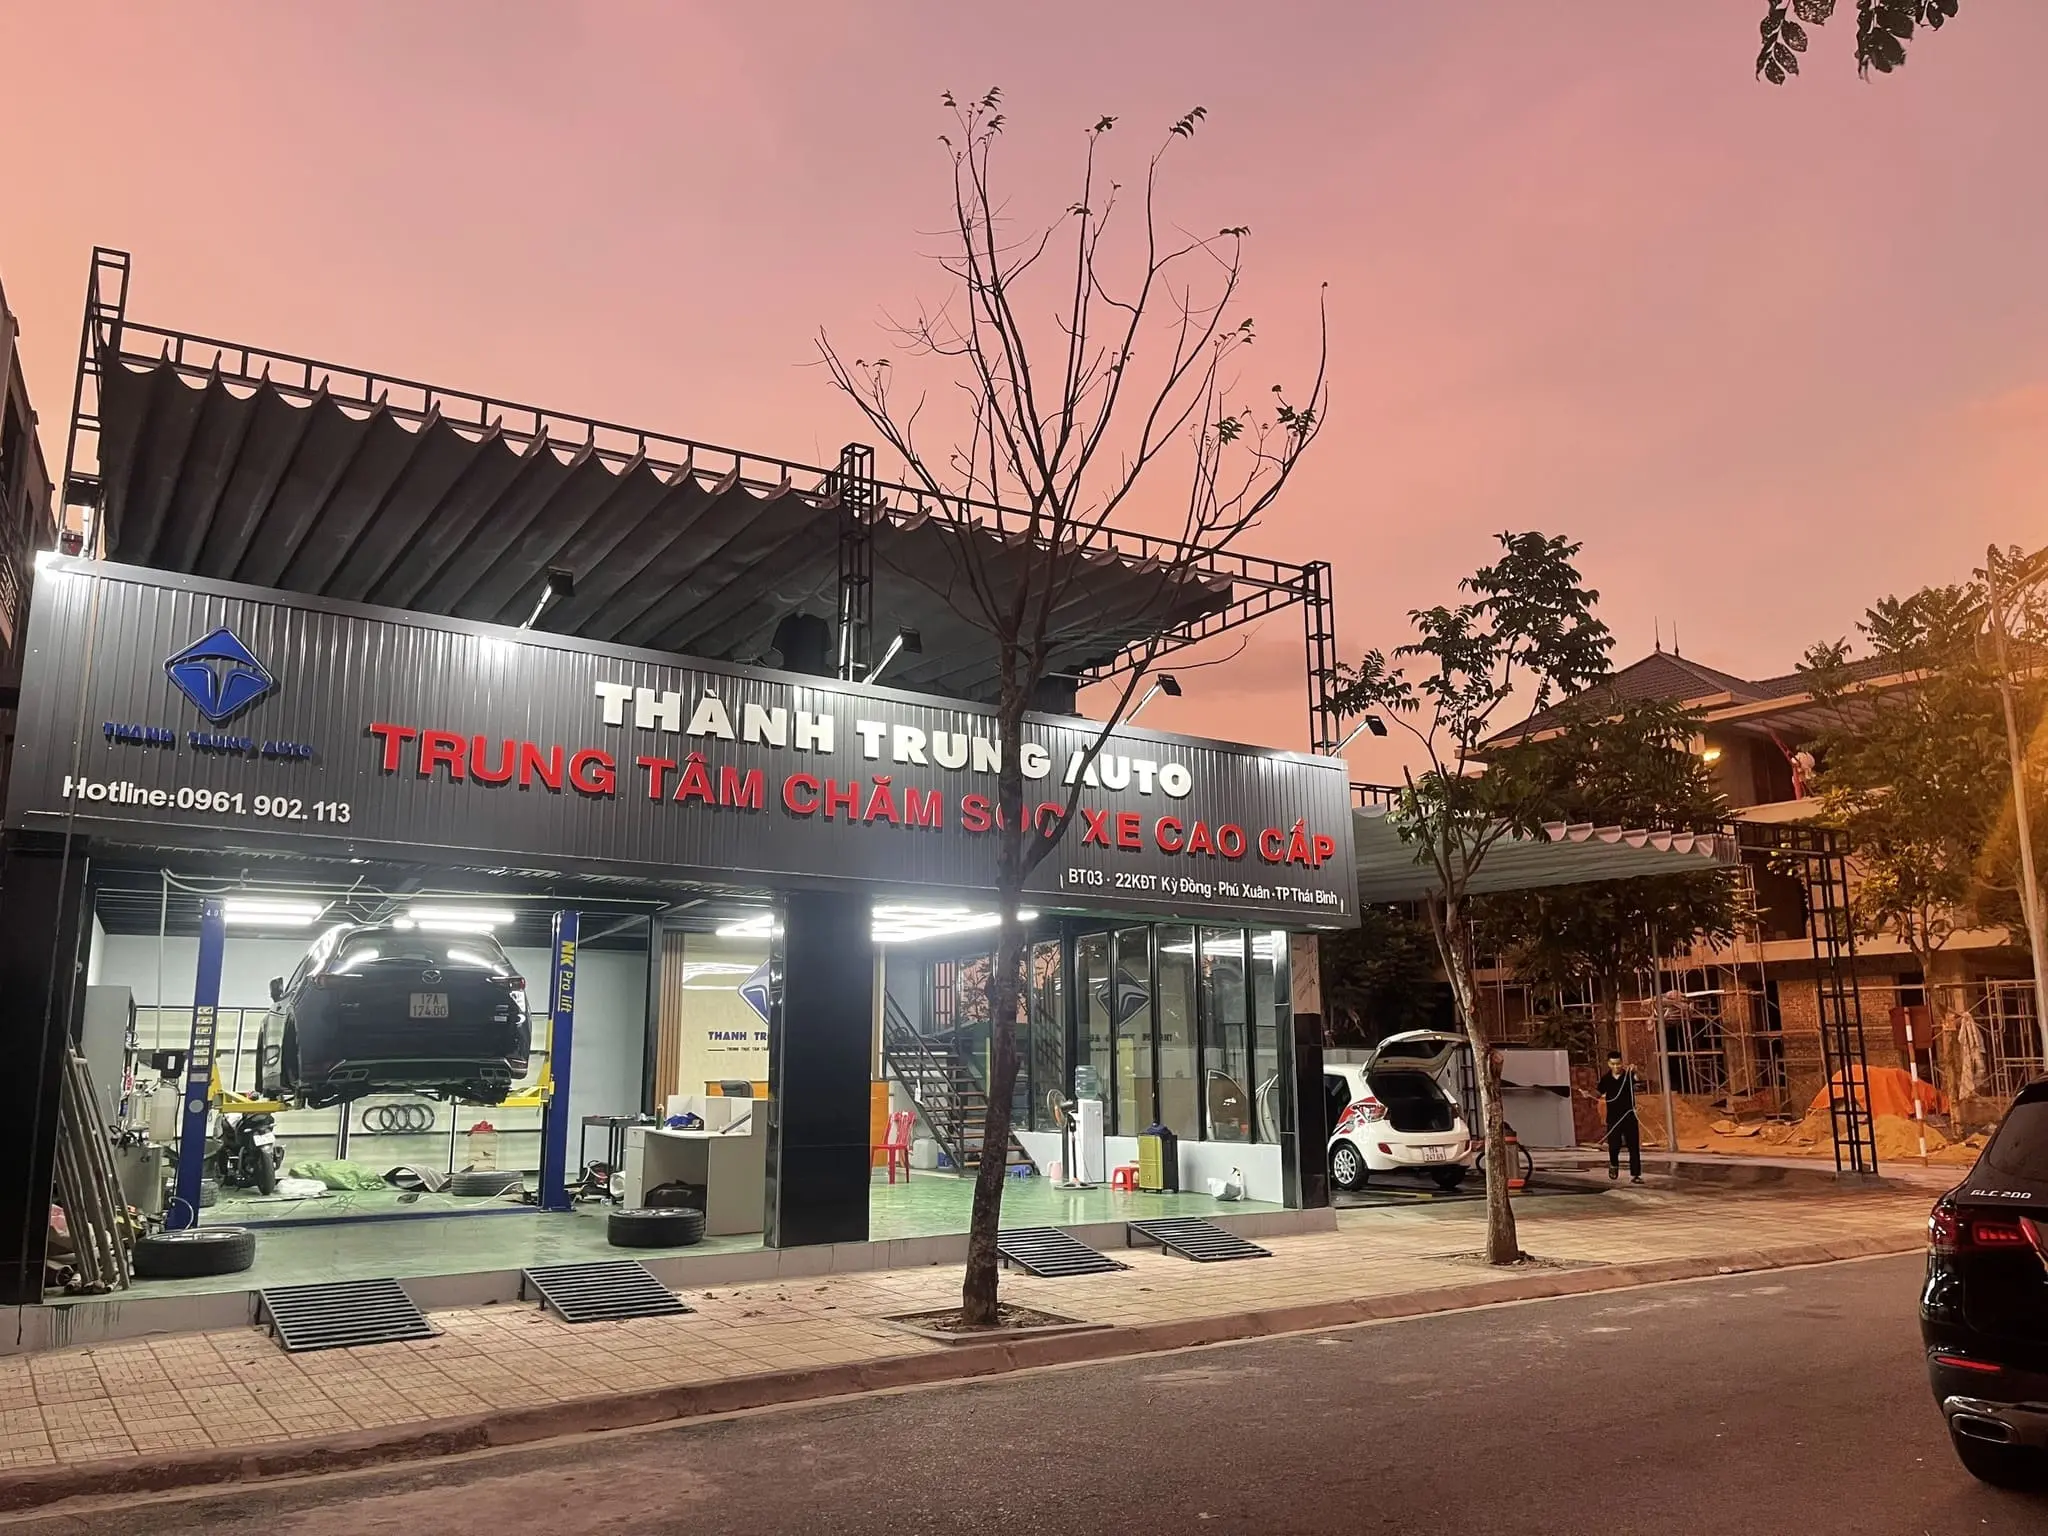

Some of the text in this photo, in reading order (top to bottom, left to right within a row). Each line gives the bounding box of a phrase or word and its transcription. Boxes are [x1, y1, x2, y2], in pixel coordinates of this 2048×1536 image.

[187, 731, 253, 750] TRUNG
[261, 740, 313, 758] AUTO
[595, 681, 834, 753] THÀNH
[1065, 751, 1192, 798] AUTO
[370, 723, 615, 795] TRUNG
[636, 752, 763, 809] TÂM
[783, 772, 943, 828] CHĂM
[1081, 808, 1143, 848] XE
[1155, 816, 1247, 858] CAO
[1259, 817, 1336, 866] CẤP
[253, 795, 307, 820] 902.
[312, 801, 351, 823] 113
[1068, 868, 1103, 887] BT03
[1115, 872, 1157, 890] 22KĐT
[1180, 876, 1212, 899] Đồng
[1219, 881, 1239, 897] Phú
[1242, 883, 1270, 900] Xuân
[1276, 886, 1289, 901] TP
[1290, 888, 1313, 904] Thái
[1315, 890, 1338, 906] Bình
[560, 941, 575, 968] NK
[562, 970, 573, 991] Pro
[420, 993, 438, 1005] 17A
[708, 1031, 747, 1041] THANH
[1970, 1189, 2032, 1199] GLC 200
